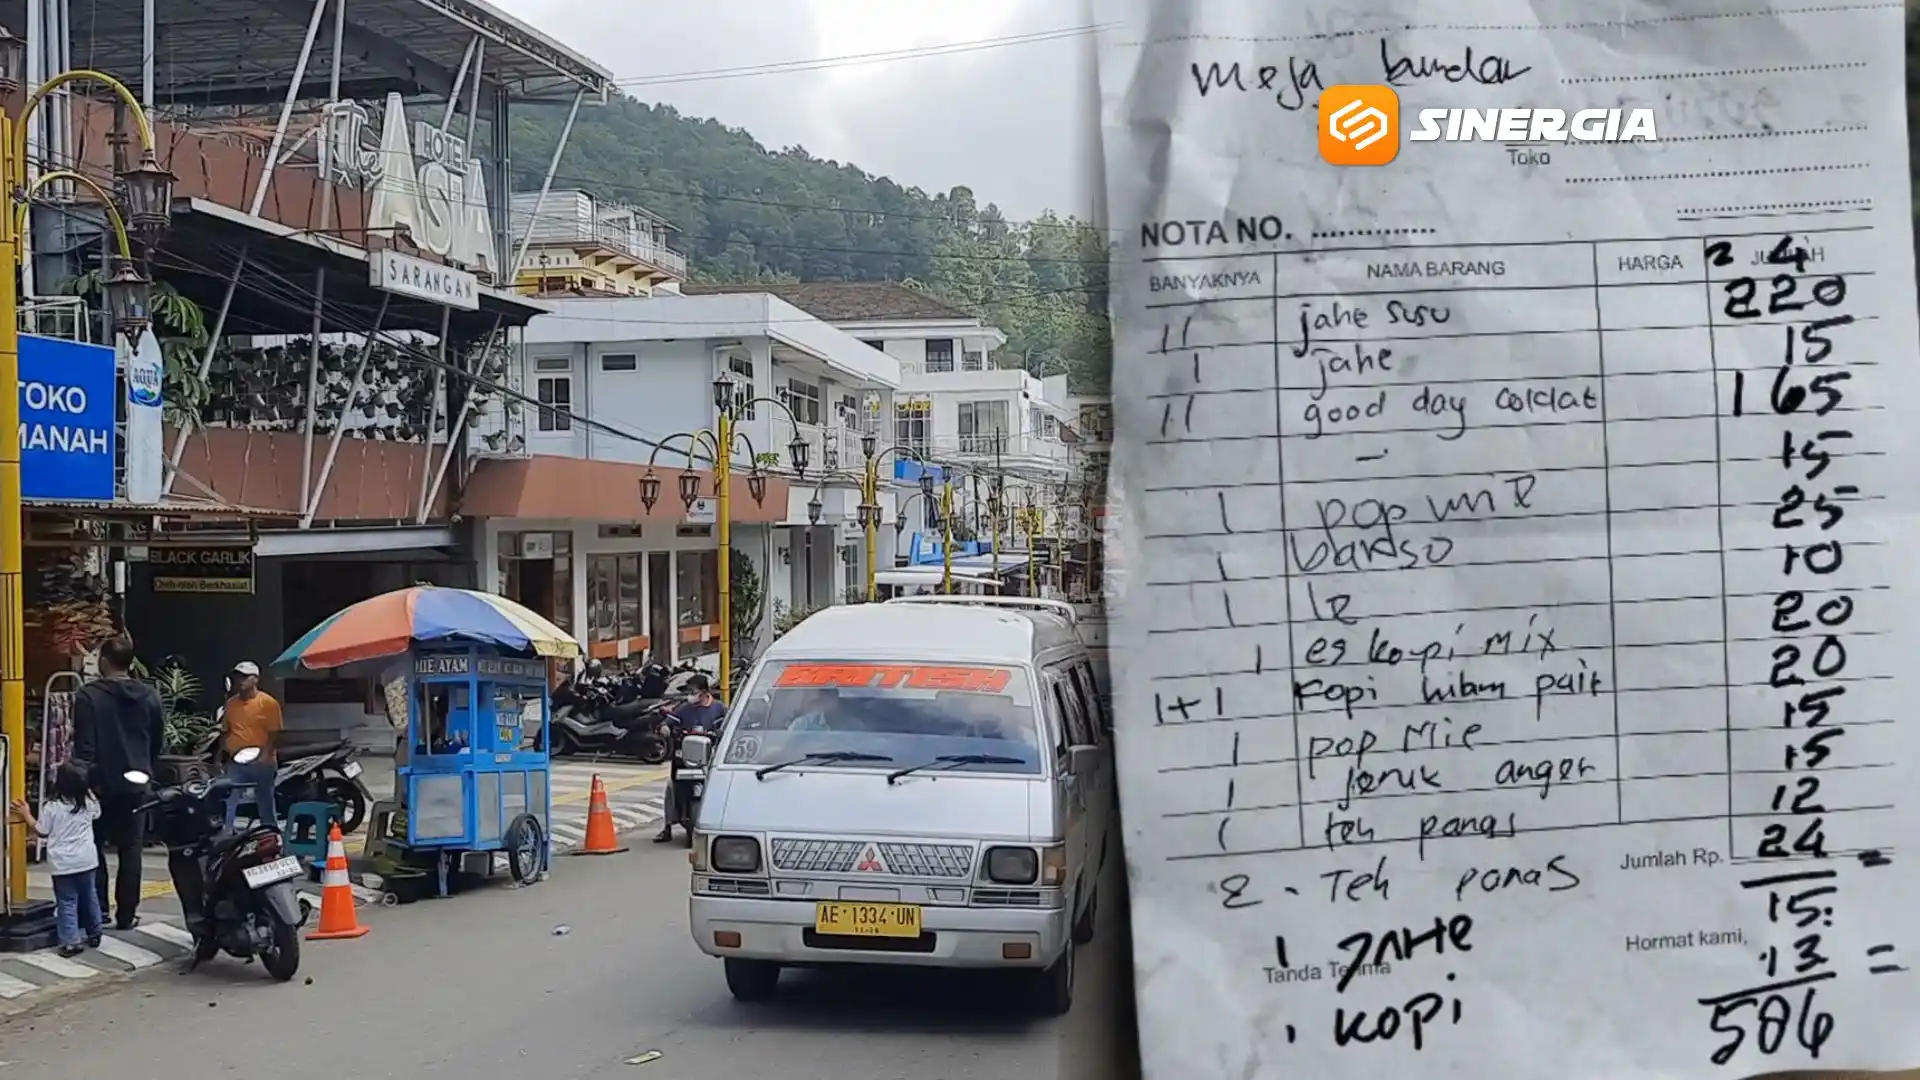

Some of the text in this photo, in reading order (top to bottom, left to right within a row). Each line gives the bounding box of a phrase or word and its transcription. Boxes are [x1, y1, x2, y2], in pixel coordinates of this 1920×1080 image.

[415, 121, 469, 174] HOTEL
[1506, 148, 1551, 166] Toko
[366, 91, 500, 272] ASIA
[1141, 214, 1293, 249] NOTA NO.
[389, 258, 473, 295] SARANGAN
[1367, 260, 1506, 278] NAMA BARANG
[1618, 253, 1684, 271] HARGA
[1150, 270, 1262, 293] BANYAKNYA
[1723, 273, 1847, 319] 220
[1293, 303, 1368, 358] jahe
[1785, 314, 1855, 365] 15
[132, 367, 159, 387] AQUA
[1311, 343, 1393, 401] jahe
[1303, 390, 1386, 440] good
[1411, 385, 1466, 441] day
[1772, 484, 1860, 531] 25
[201, 550, 250, 565] GARLIK
[1782, 540, 1843, 575] 10
[1771, 590, 1854, 633] 20
[438, 657, 469, 673] AYAM
[1770, 633, 1847, 688] 20
[1784, 685, 1847, 728] 15
[1784, 728, 1845, 770] 15
[1771, 775, 1827, 815] 12
[1757, 817, 1828, 858] 24
[1620, 848, 1724, 870] Jumlah Rp.
[821, 905, 915, 926] AE 1334 UN
[1626, 928, 1748, 952] Hormat kami,
[1263, 964, 1322, 984] Tanda
